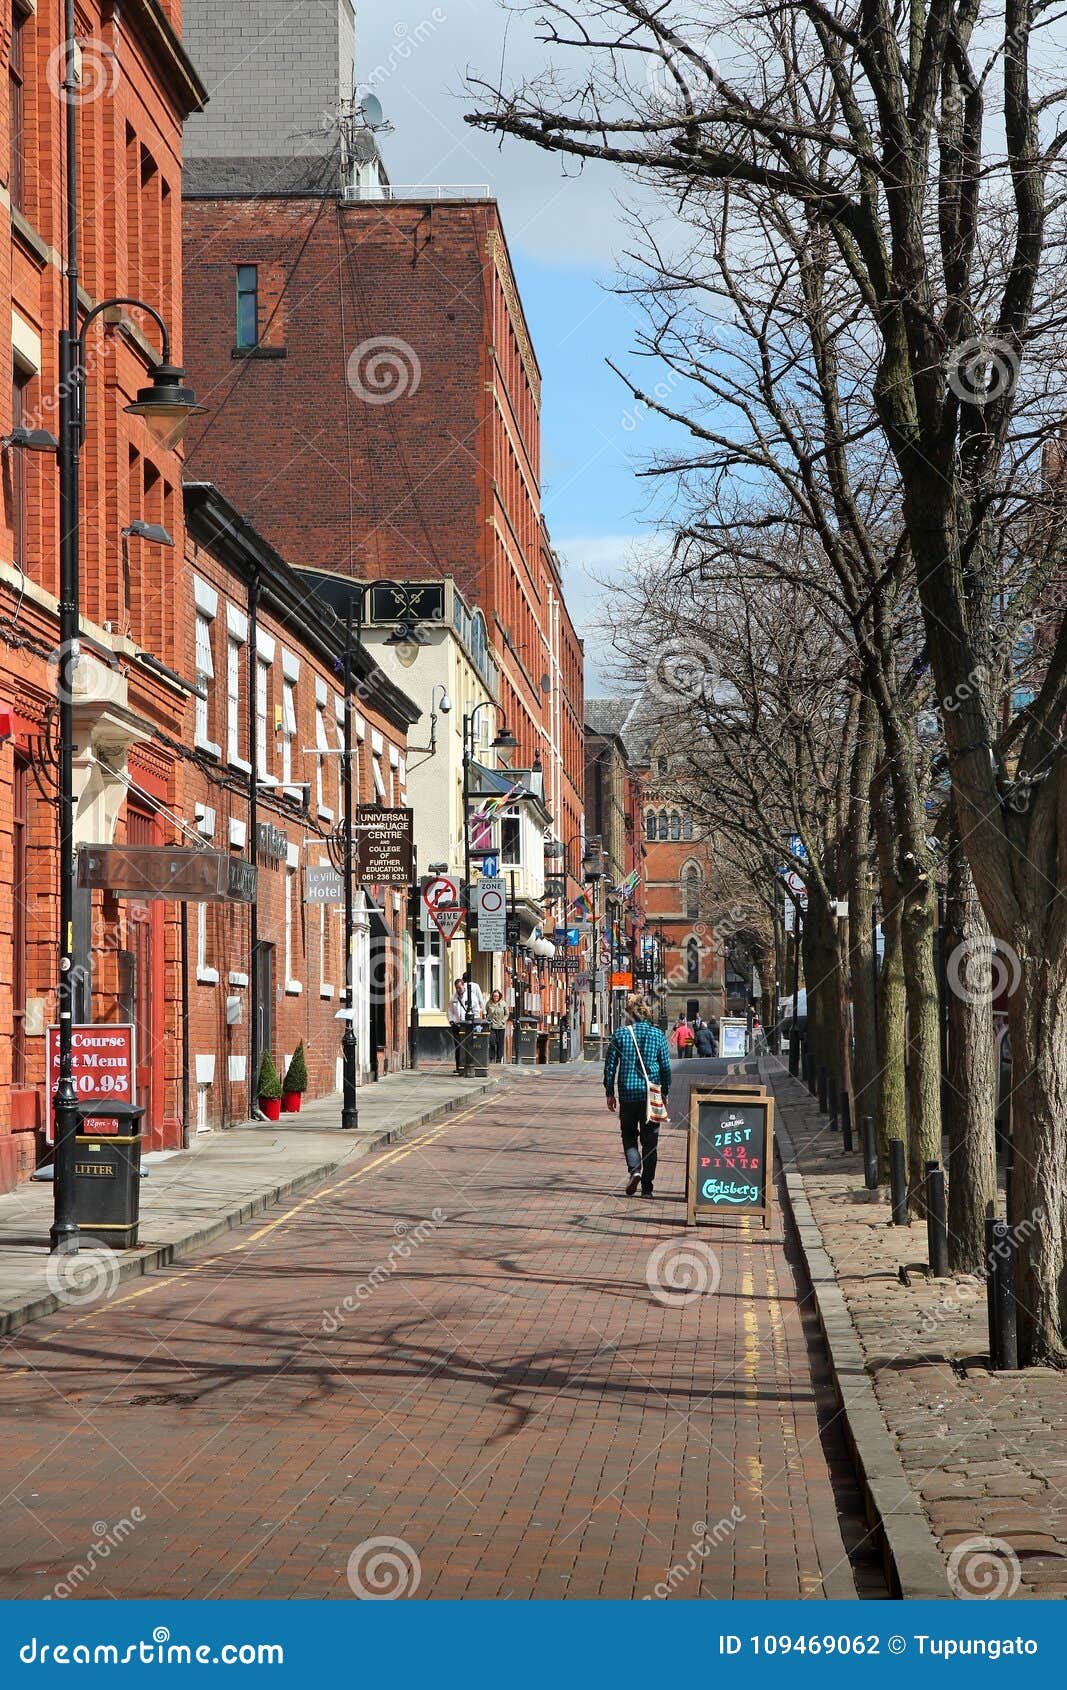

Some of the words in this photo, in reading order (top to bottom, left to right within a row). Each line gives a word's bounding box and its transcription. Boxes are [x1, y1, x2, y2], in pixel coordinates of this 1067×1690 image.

[361, 813, 409, 822] UNIVERSAL
[368, 831, 402, 839] CENTRE
[320, 871, 341, 882] Ville
[392, 873, 408, 881] 5331
[309, 884, 341, 897] Hotel
[436, 912, 458, 920] GIVE
[71, 1033, 126, 1048] Course
[53, 1055, 79, 1068] St
[82, 1053, 128, 1068] Menu
[714, 1128, 752, 1147] ZEST
[701, 1157, 759, 1169] PINTS
[74, 1164, 114, 1175] LITTER
[701, 1178, 759, 1204] Carlsberg
